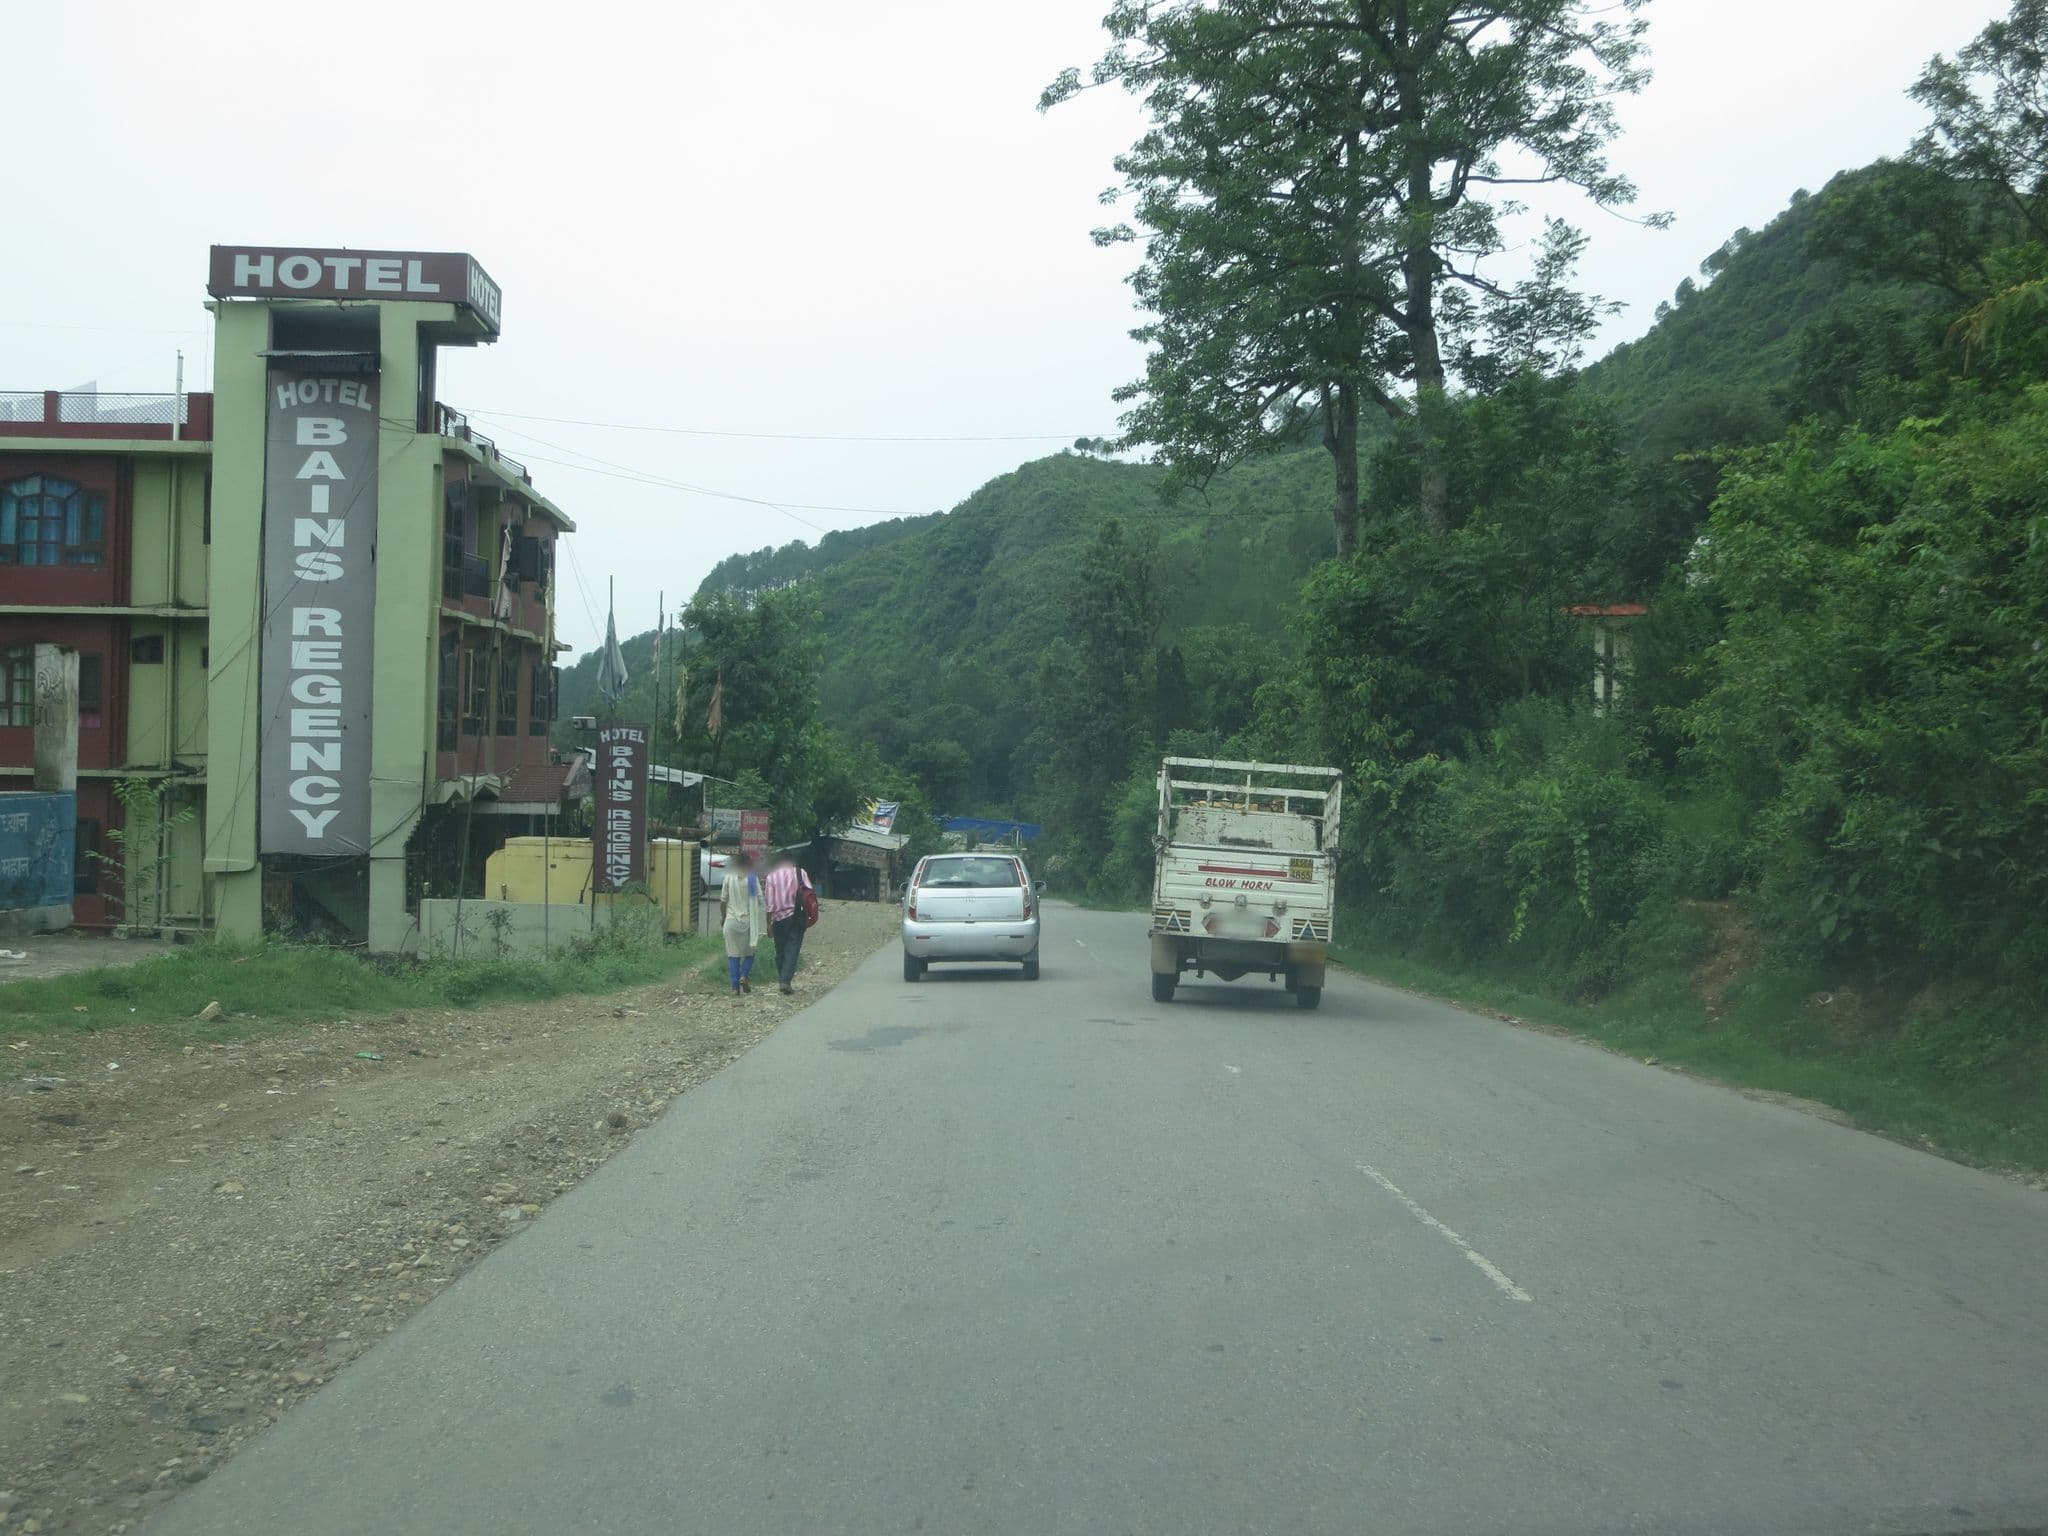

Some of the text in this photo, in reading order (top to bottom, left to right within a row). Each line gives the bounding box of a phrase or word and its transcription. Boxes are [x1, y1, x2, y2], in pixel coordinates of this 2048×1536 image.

[234, 254, 440, 293] HOTEL
[471, 265, 500, 325] HOTEL
[276, 378, 373, 411] HOTEL
[289, 416, 348, 838] BAINS REGENCY
[600, 728, 645, 743] HOTEL
[606, 745, 634, 887] BAINS REGENCY
[1205, 877, 1273, 890] BLOW HORN
